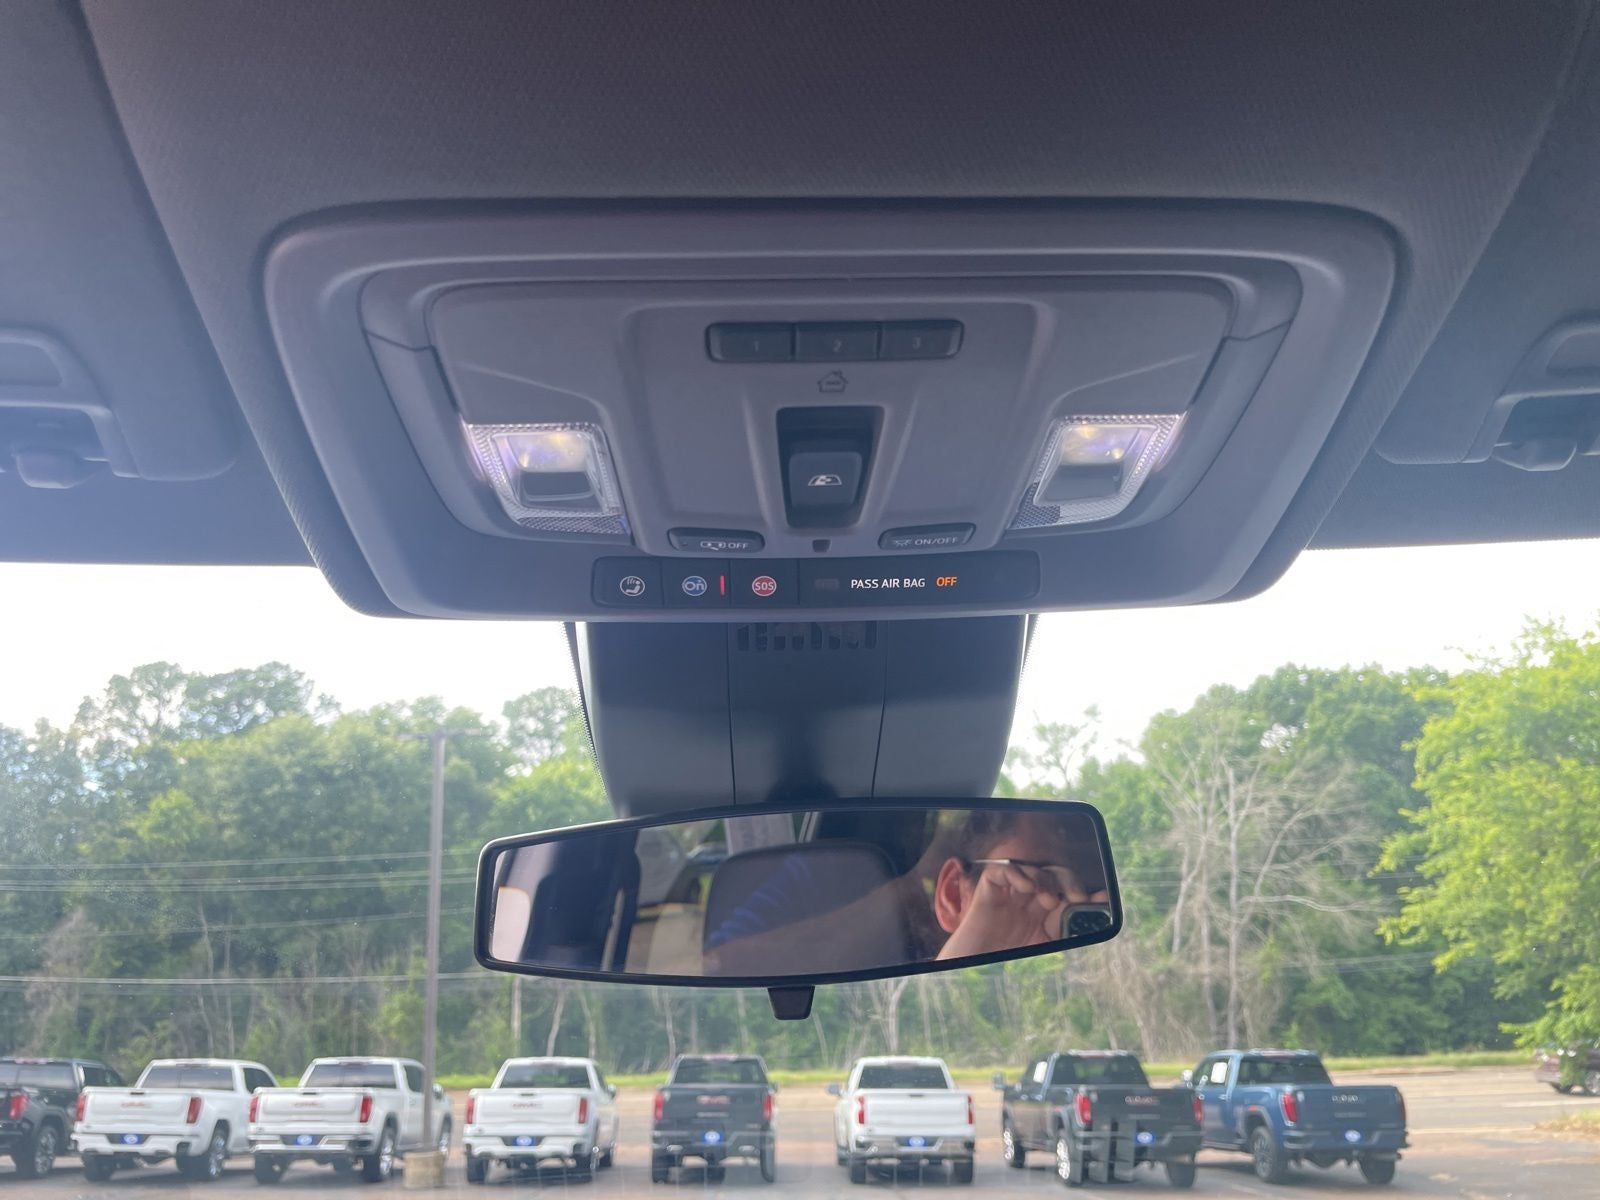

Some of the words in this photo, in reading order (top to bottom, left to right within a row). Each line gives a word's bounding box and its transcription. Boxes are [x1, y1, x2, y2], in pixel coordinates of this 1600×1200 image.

[914, 536, 958, 546] ON/OFF
[754, 580, 774, 591] SOS
[850, 578, 879, 589] PASS
[881, 578, 900, 589] AIR
[903, 578, 926, 588] BAG
[936, 576, 957, 587] OFF
